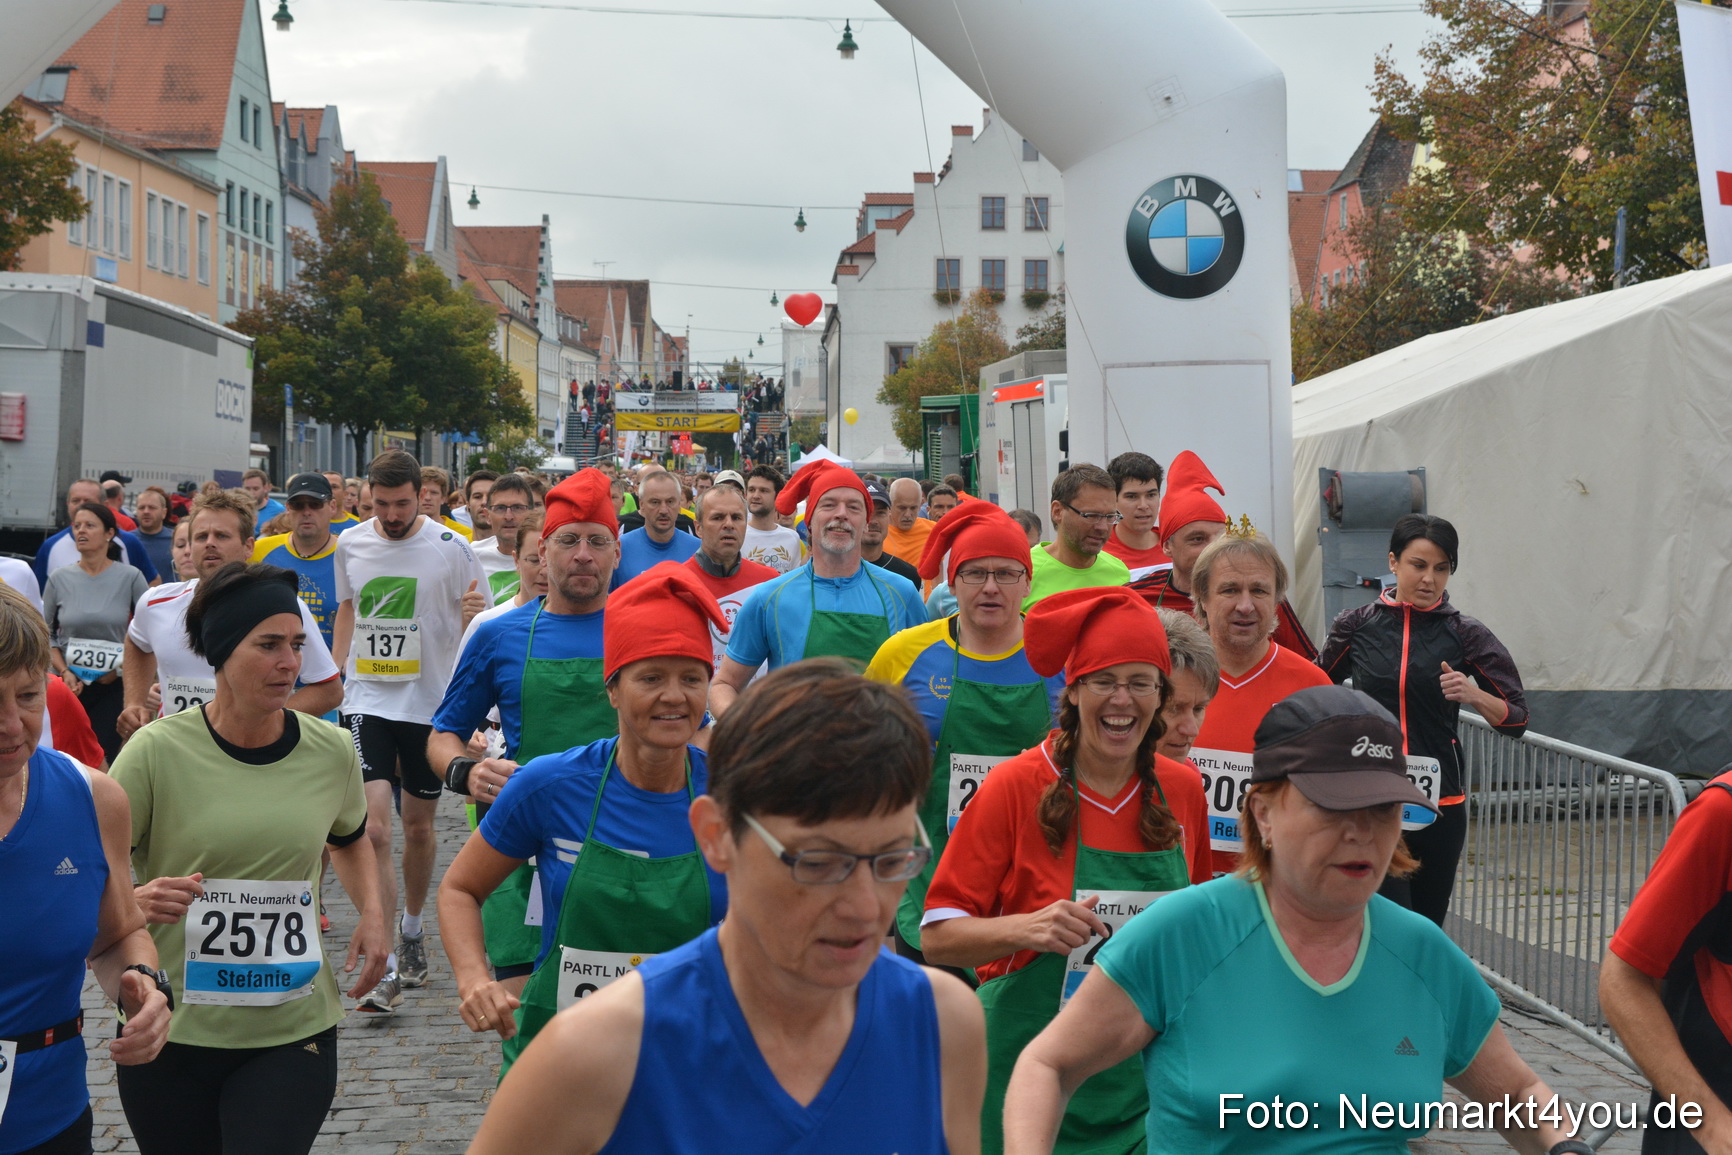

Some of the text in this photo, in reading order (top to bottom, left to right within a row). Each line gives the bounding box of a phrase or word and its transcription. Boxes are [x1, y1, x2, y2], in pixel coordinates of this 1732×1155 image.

[1136, 177, 1236, 219] BMW
[215, 378, 246, 423] BOCK
[655, 416, 699, 427] START
[356, 623, 374, 631] PARTL
[366, 633, 406, 657] 137
[72, 648, 118, 670] 2397
[372, 662, 399, 673] Stefan
[168, 683, 192, 693] PARTL
[952, 763, 985, 774] PARTL
[1188, 757, 1220, 769] ARTL
[53, 866, 79, 876] adidas
[240, 892, 296, 905] Neumarkt
[200, 910, 308, 958] 2578
[564, 961, 631, 978] PARTL N
[217, 969, 291, 989] Stefanie
[1393, 1048, 1420, 1057] adidas
